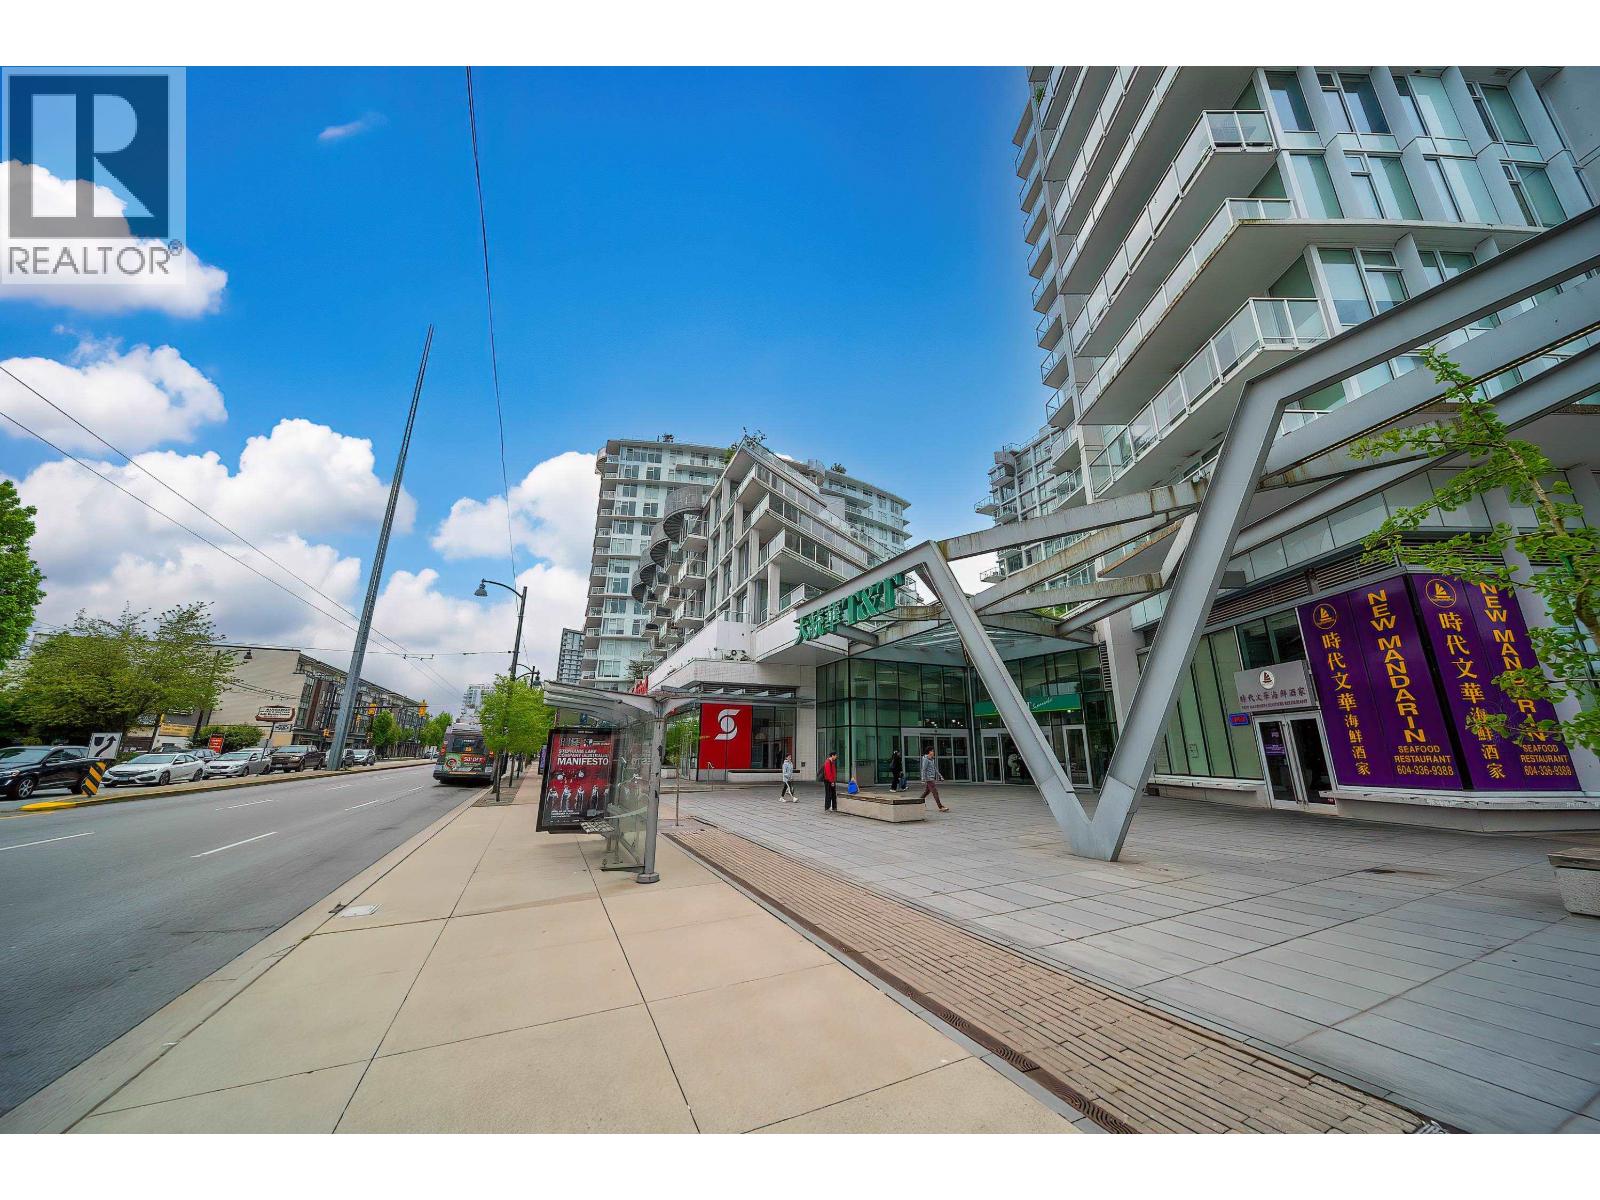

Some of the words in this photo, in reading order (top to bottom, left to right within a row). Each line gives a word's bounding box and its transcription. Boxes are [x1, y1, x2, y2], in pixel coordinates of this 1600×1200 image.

[840, 574, 905, 626] T&T
[1367, 589, 1397, 632] NEW
[1479, 581, 1508, 623] NEW
[1377, 635, 1427, 744] MANDARIN
[1492, 629, 1547, 742] MANRIN
[1321, 632, 1371, 776] 時代文華海鮮酒家
[557, 757, 609, 765] MANIFESTO
[1393, 755, 1452, 764] RESTAURANT
[1397, 745, 1441, 753] SEAFOOD
[1520, 754, 1569, 763] RESTAURANT
[1522, 744, 1559, 753] SEAFOOD
[1397, 765, 1454, 776] 604-336-9388
